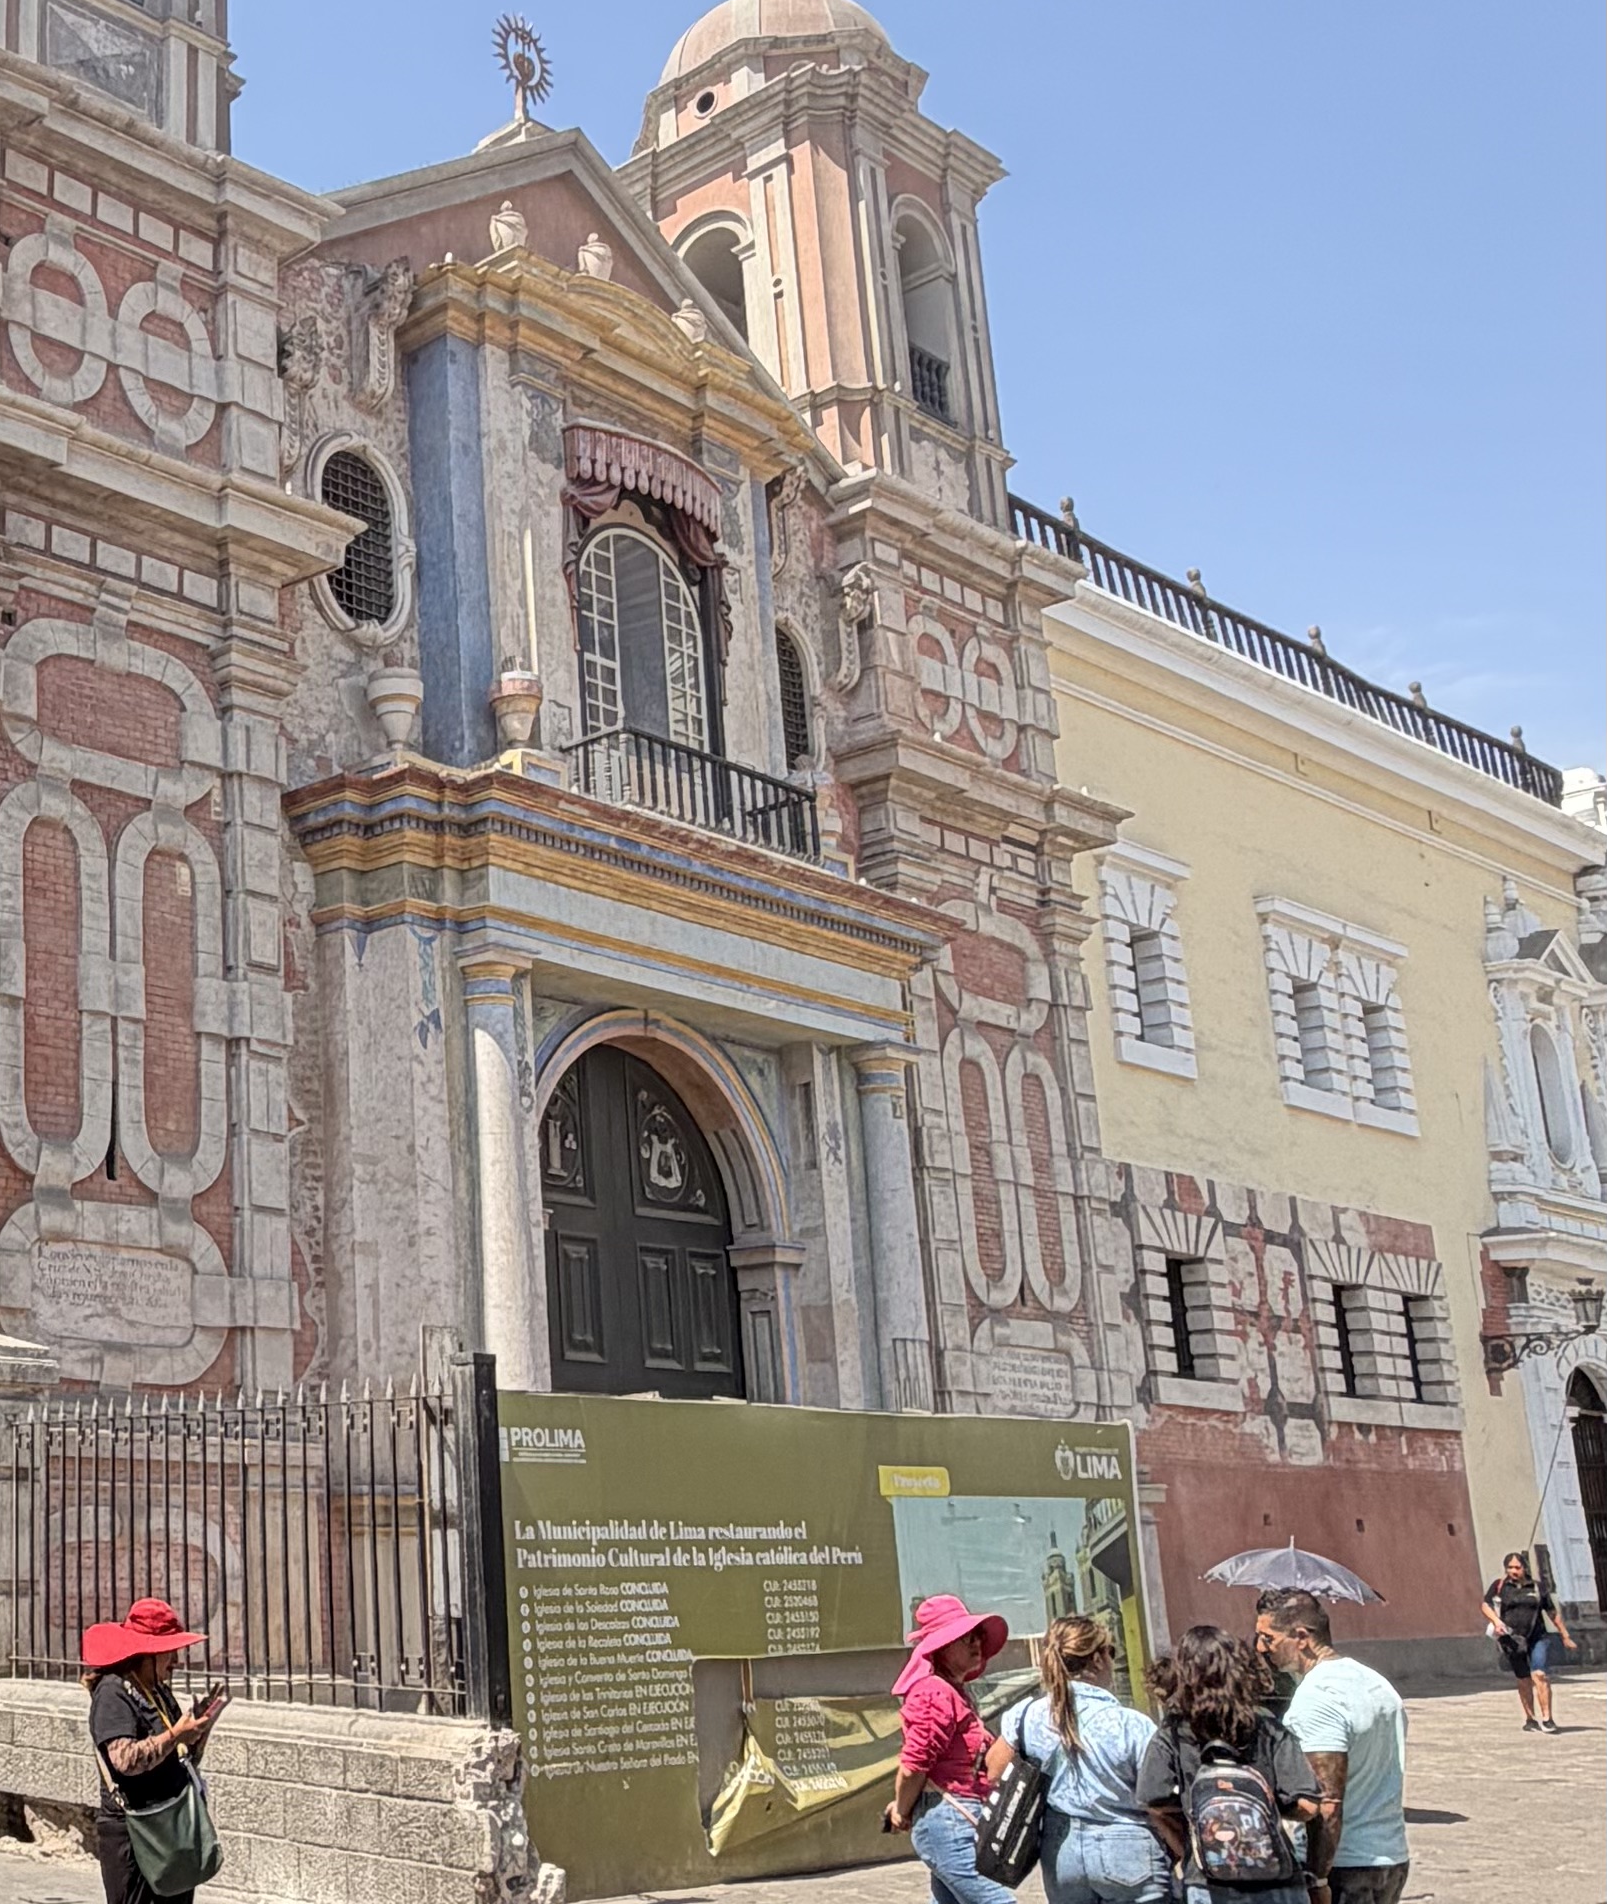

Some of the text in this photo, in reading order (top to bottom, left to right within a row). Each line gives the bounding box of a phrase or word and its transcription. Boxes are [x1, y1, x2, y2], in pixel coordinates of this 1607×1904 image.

[510, 1427, 586, 1449] PROLIMA
[1076, 1454, 1122, 1481] LIMA
[514, 1519, 807, 1546] La Municipalidad de Lima restaurando el
[516, 1545, 862, 1572] Patrimonio Cultural de la Iglesia católica del Perú
[533, 1584, 560, 1600] Iglesia
[562, 1583, 573, 1596] de
[574, 1583, 598, 1596] Santa
[620, 1582, 669, 1595] CONCLUIDA
[534, 1599, 668, 1617] Iglesia de la Soledad CONCLUIDA
[535, 1618, 563, 1636] Iglesia
[564, 1618, 575, 1631] de
[536, 1637, 563, 1653] Iglesia
[564, 1636, 576, 1649] de
[577, 1636, 586, 1648] la
[537, 1654, 565, 1671] Iglesia
[566, 1654, 578, 1666] de
[579, 1653, 588, 1666] la
[589, 1652, 615, 1665] Buena
[645, 1649, 693, 1663] CONCLUIDA
[538, 1673, 567, 1689] Iglesia
[574, 1670, 614, 1685] Convento
[615, 1669, 626, 1682] de
[651, 1667, 688, 1682] Domingo
[540, 1690, 568, 1707] Iglesia
[569, 1689, 580, 1702] de
[634, 1684, 648, 1698] EN
[541, 1708, 569, 1725] Iglesia
[570, 1707, 581, 1720] de
[582, 1705, 599, 1719] San
[600, 1704, 627, 1718] Carlos
[628, 1702, 642, 1716] EN
[543, 1726, 570, 1743] Iglesia
[571, 1726, 582, 1738] de
[621, 1721, 634, 1734] del
[670, 1717, 683, 1731] EN
[543, 1744, 571, 1761] Iglesia
[622, 1738, 634, 1752] de
[675, 1734, 689, 1748] EN
[649, 1753, 662, 1767] del
